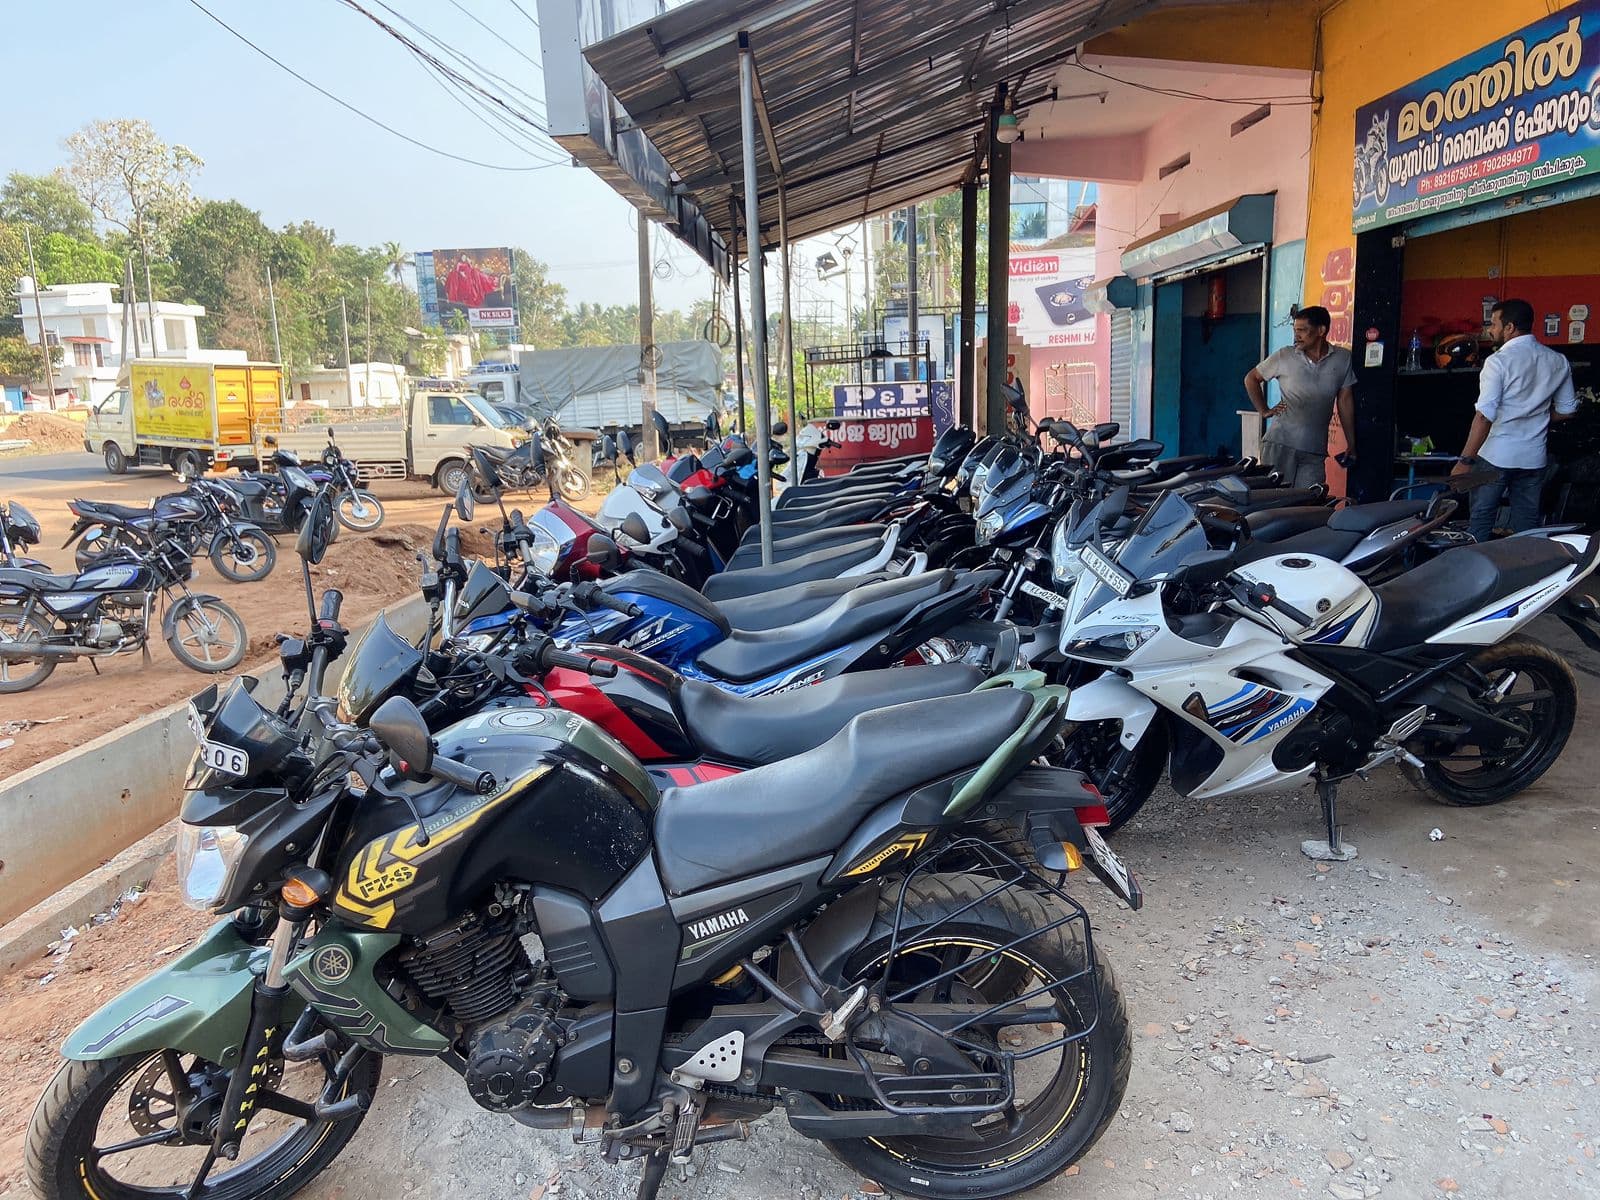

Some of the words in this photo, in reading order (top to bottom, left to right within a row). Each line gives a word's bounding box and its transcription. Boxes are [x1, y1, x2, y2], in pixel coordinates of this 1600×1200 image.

[1397, 16, 1582, 143] മറത്തിൽ
[1420, 179, 1433, 192] Ph:
[1482, 146, 1533, 173] 7902894977
[1048, 332, 1081, 344] RESHMI
[844, 387, 876, 407] P
[1267, 706, 1306, 732] YAMAHA
[687, 908, 750, 940] YAMAHA
[234, 1026, 277, 1131] YAMAHA
